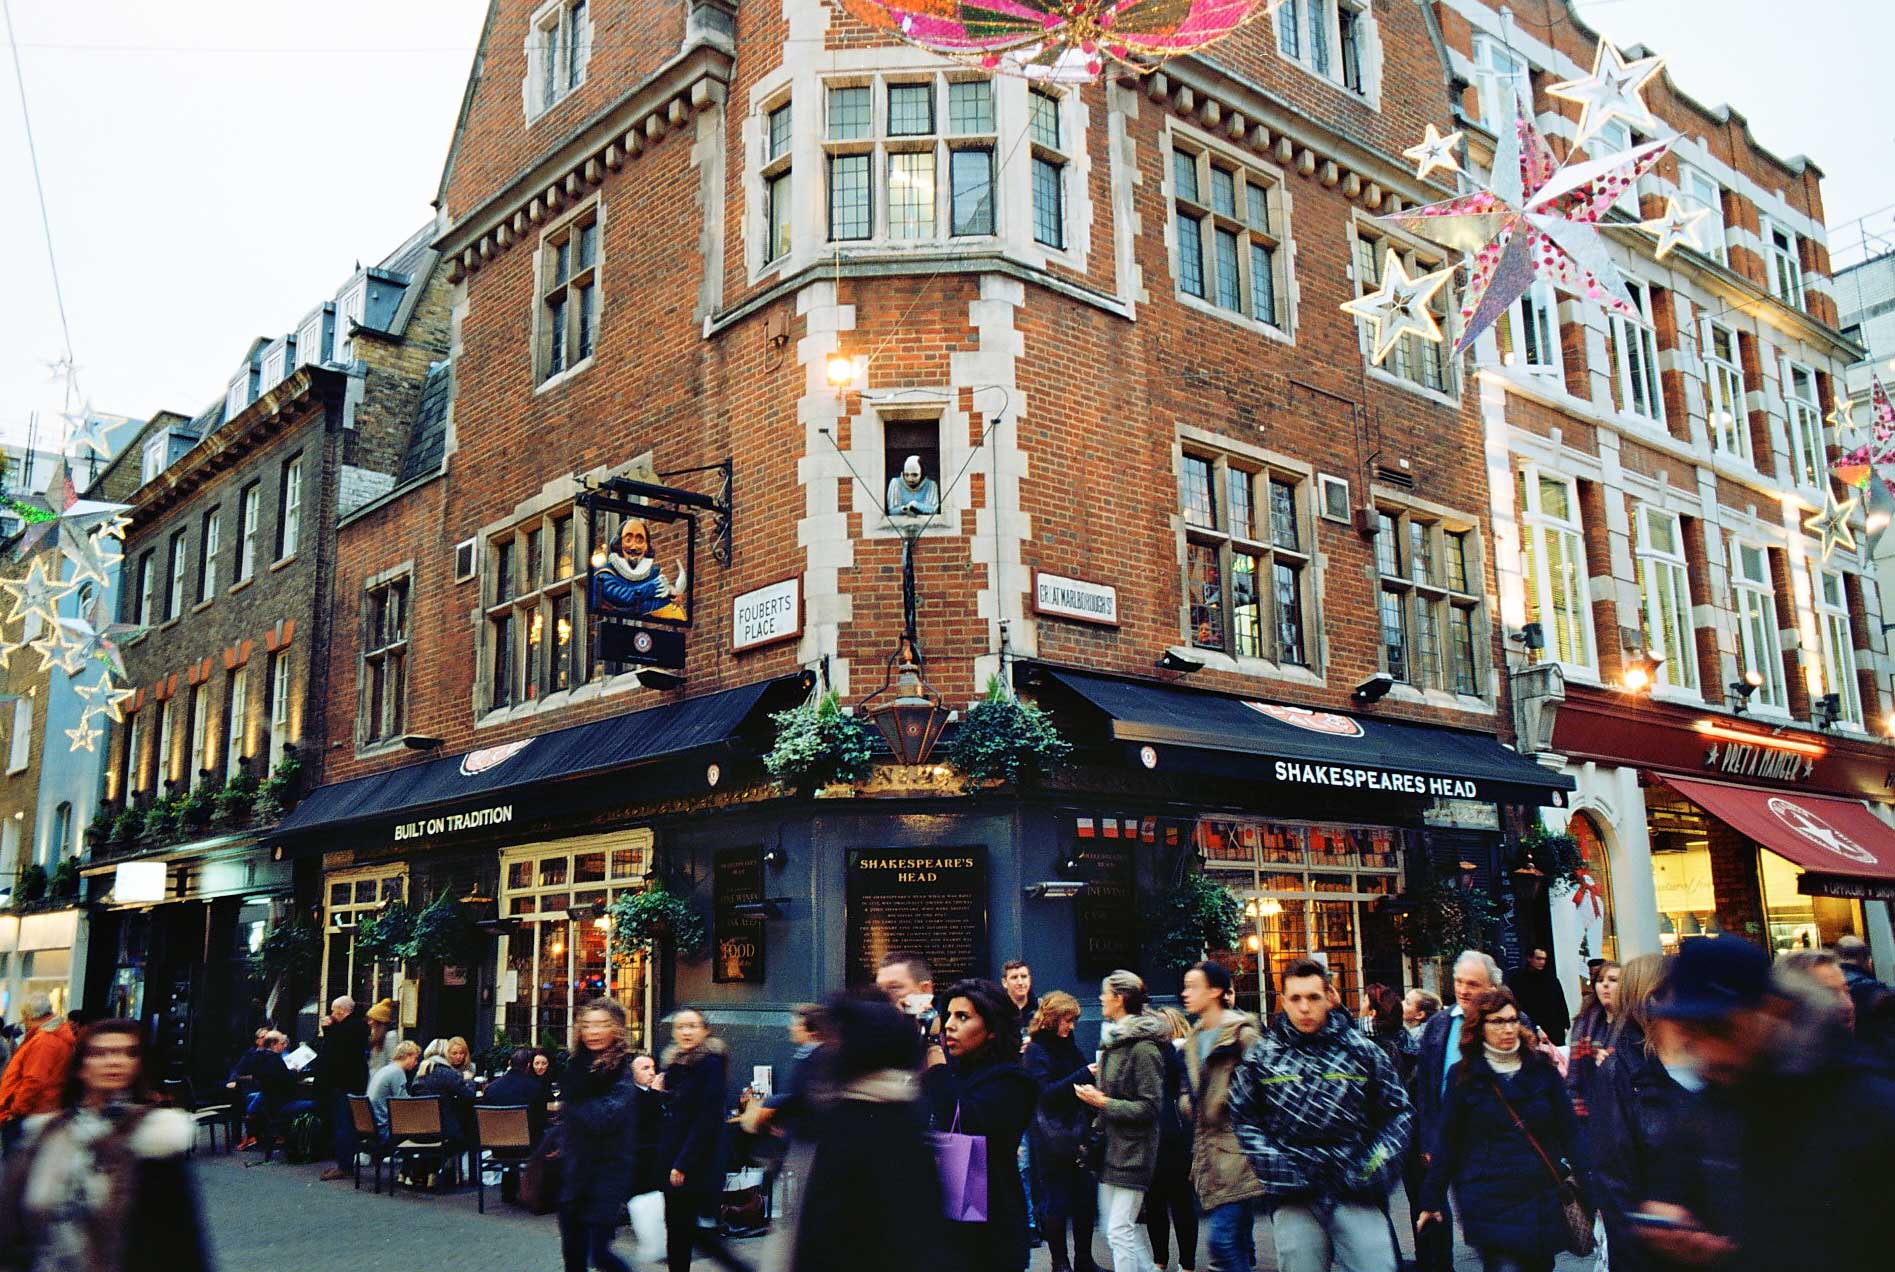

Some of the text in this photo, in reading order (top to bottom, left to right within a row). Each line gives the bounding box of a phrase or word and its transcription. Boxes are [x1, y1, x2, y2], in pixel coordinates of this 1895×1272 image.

[739, 595, 791, 624] FOUBERTS
[1060, 587, 1106, 614] MARLBOROUGH
[745, 618, 775, 640] PLACE
[1721, 742, 1802, 780] PRET A MANGER
[1274, 760, 1477, 798] SHAKESPEARES HEAD
[394, 804, 513, 841] BUILT ON TRADITION
[860, 858, 974, 869] SHAKESPEARE'S
[898, 872, 937, 883] HEAD
[721, 943, 755, 959] FOOD
